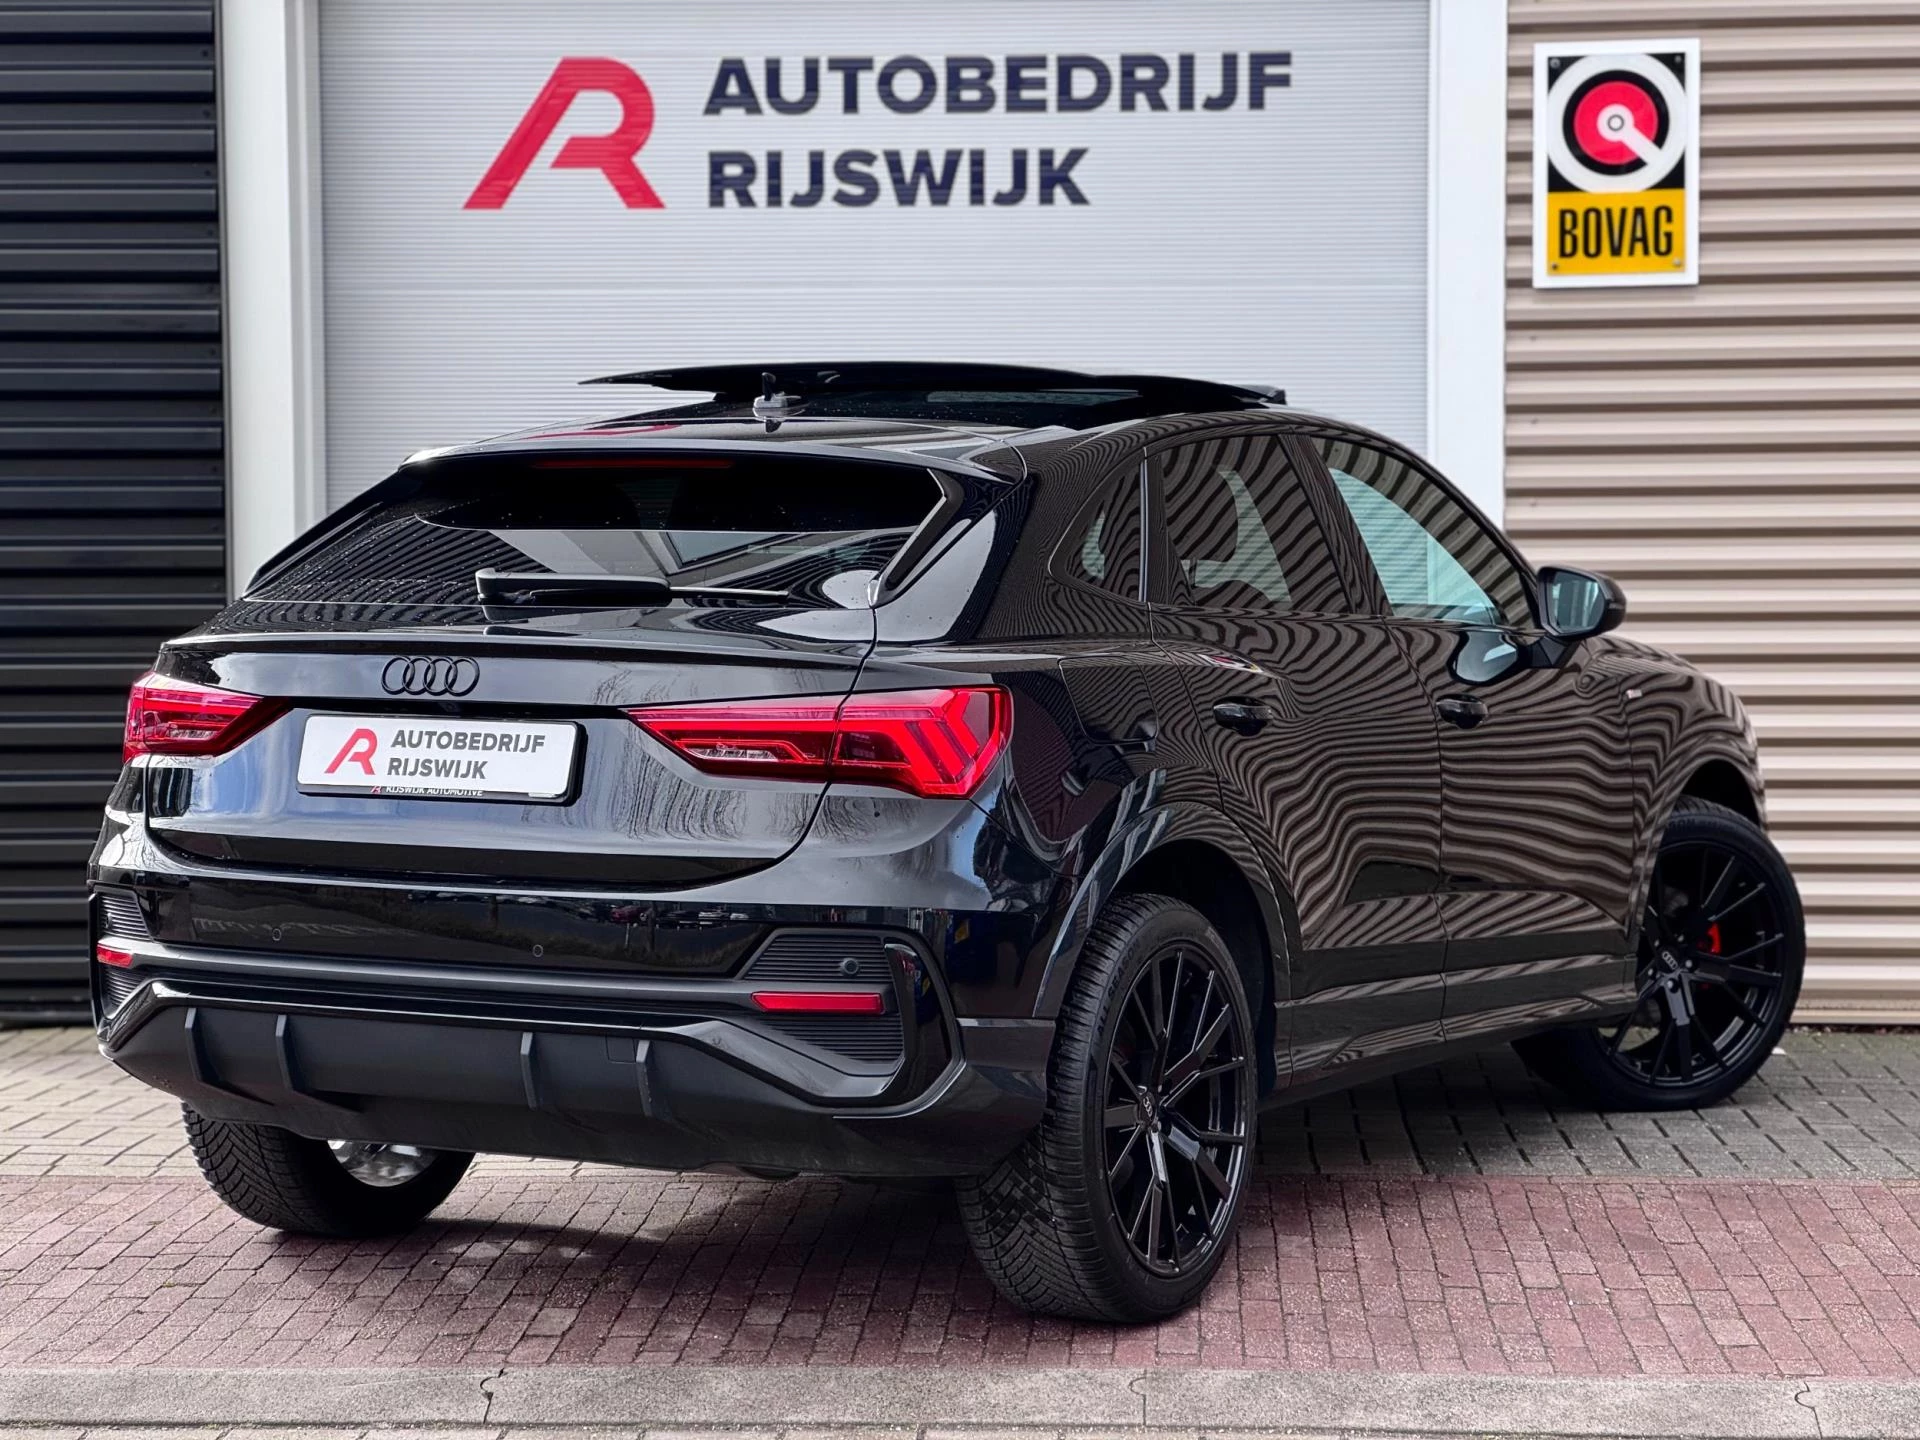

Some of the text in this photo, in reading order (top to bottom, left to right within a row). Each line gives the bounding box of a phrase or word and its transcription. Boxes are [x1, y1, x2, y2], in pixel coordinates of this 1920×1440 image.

[703, 51, 1292, 116] AUTOBEDRIJF
[708, 148, 1090, 208] RIJSWIJK
[1559, 205, 1673, 258] BOVAG
[391, 730, 545, 753] AUTOBEDRIJF
[387, 757, 488, 780] RIJSWIJK
